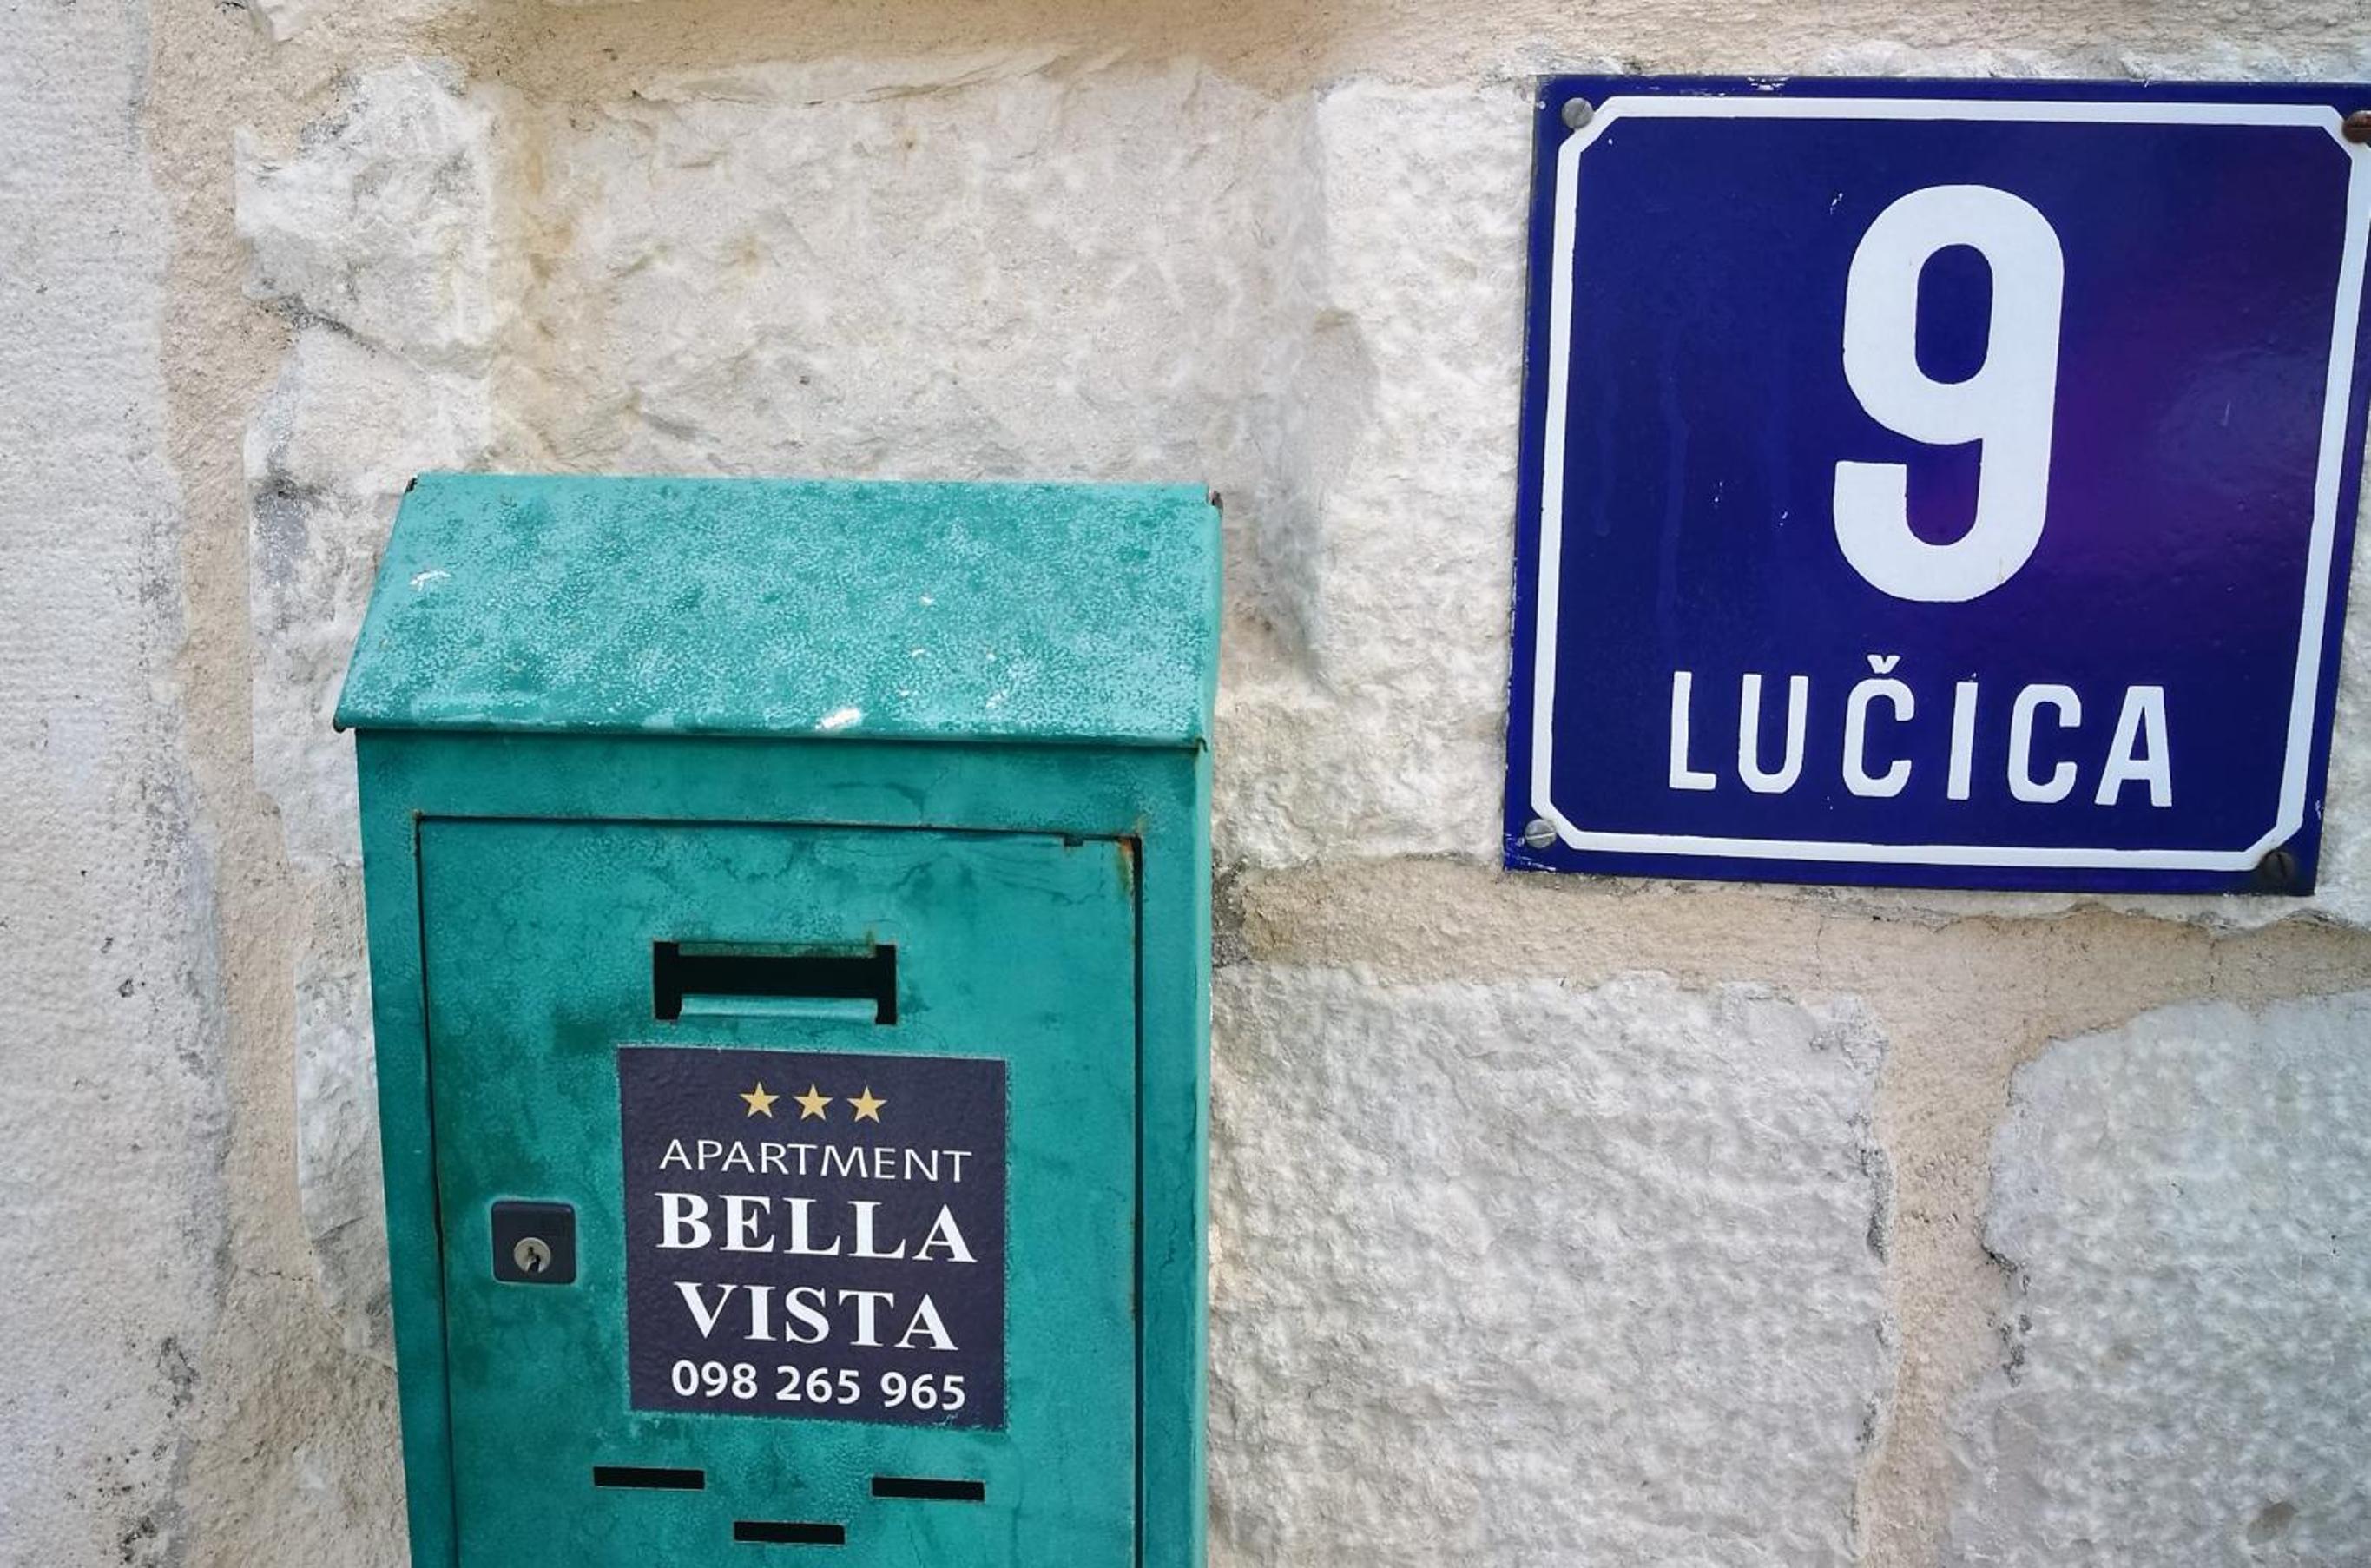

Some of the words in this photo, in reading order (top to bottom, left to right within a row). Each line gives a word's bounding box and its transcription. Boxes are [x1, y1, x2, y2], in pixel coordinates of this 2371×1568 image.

[1833, 183, 2065, 603] 9
[1668, 653, 2173, 807] LUČICA
[658, 1138, 972, 1183] APARTMENT
[654, 1191, 978, 1263] BELLA
[674, 1281, 959, 1351] VISTA
[671, 1360, 759, 1400] 098
[775, 1365, 861, 1406] 265
[880, 1371, 966, 1412] 965
